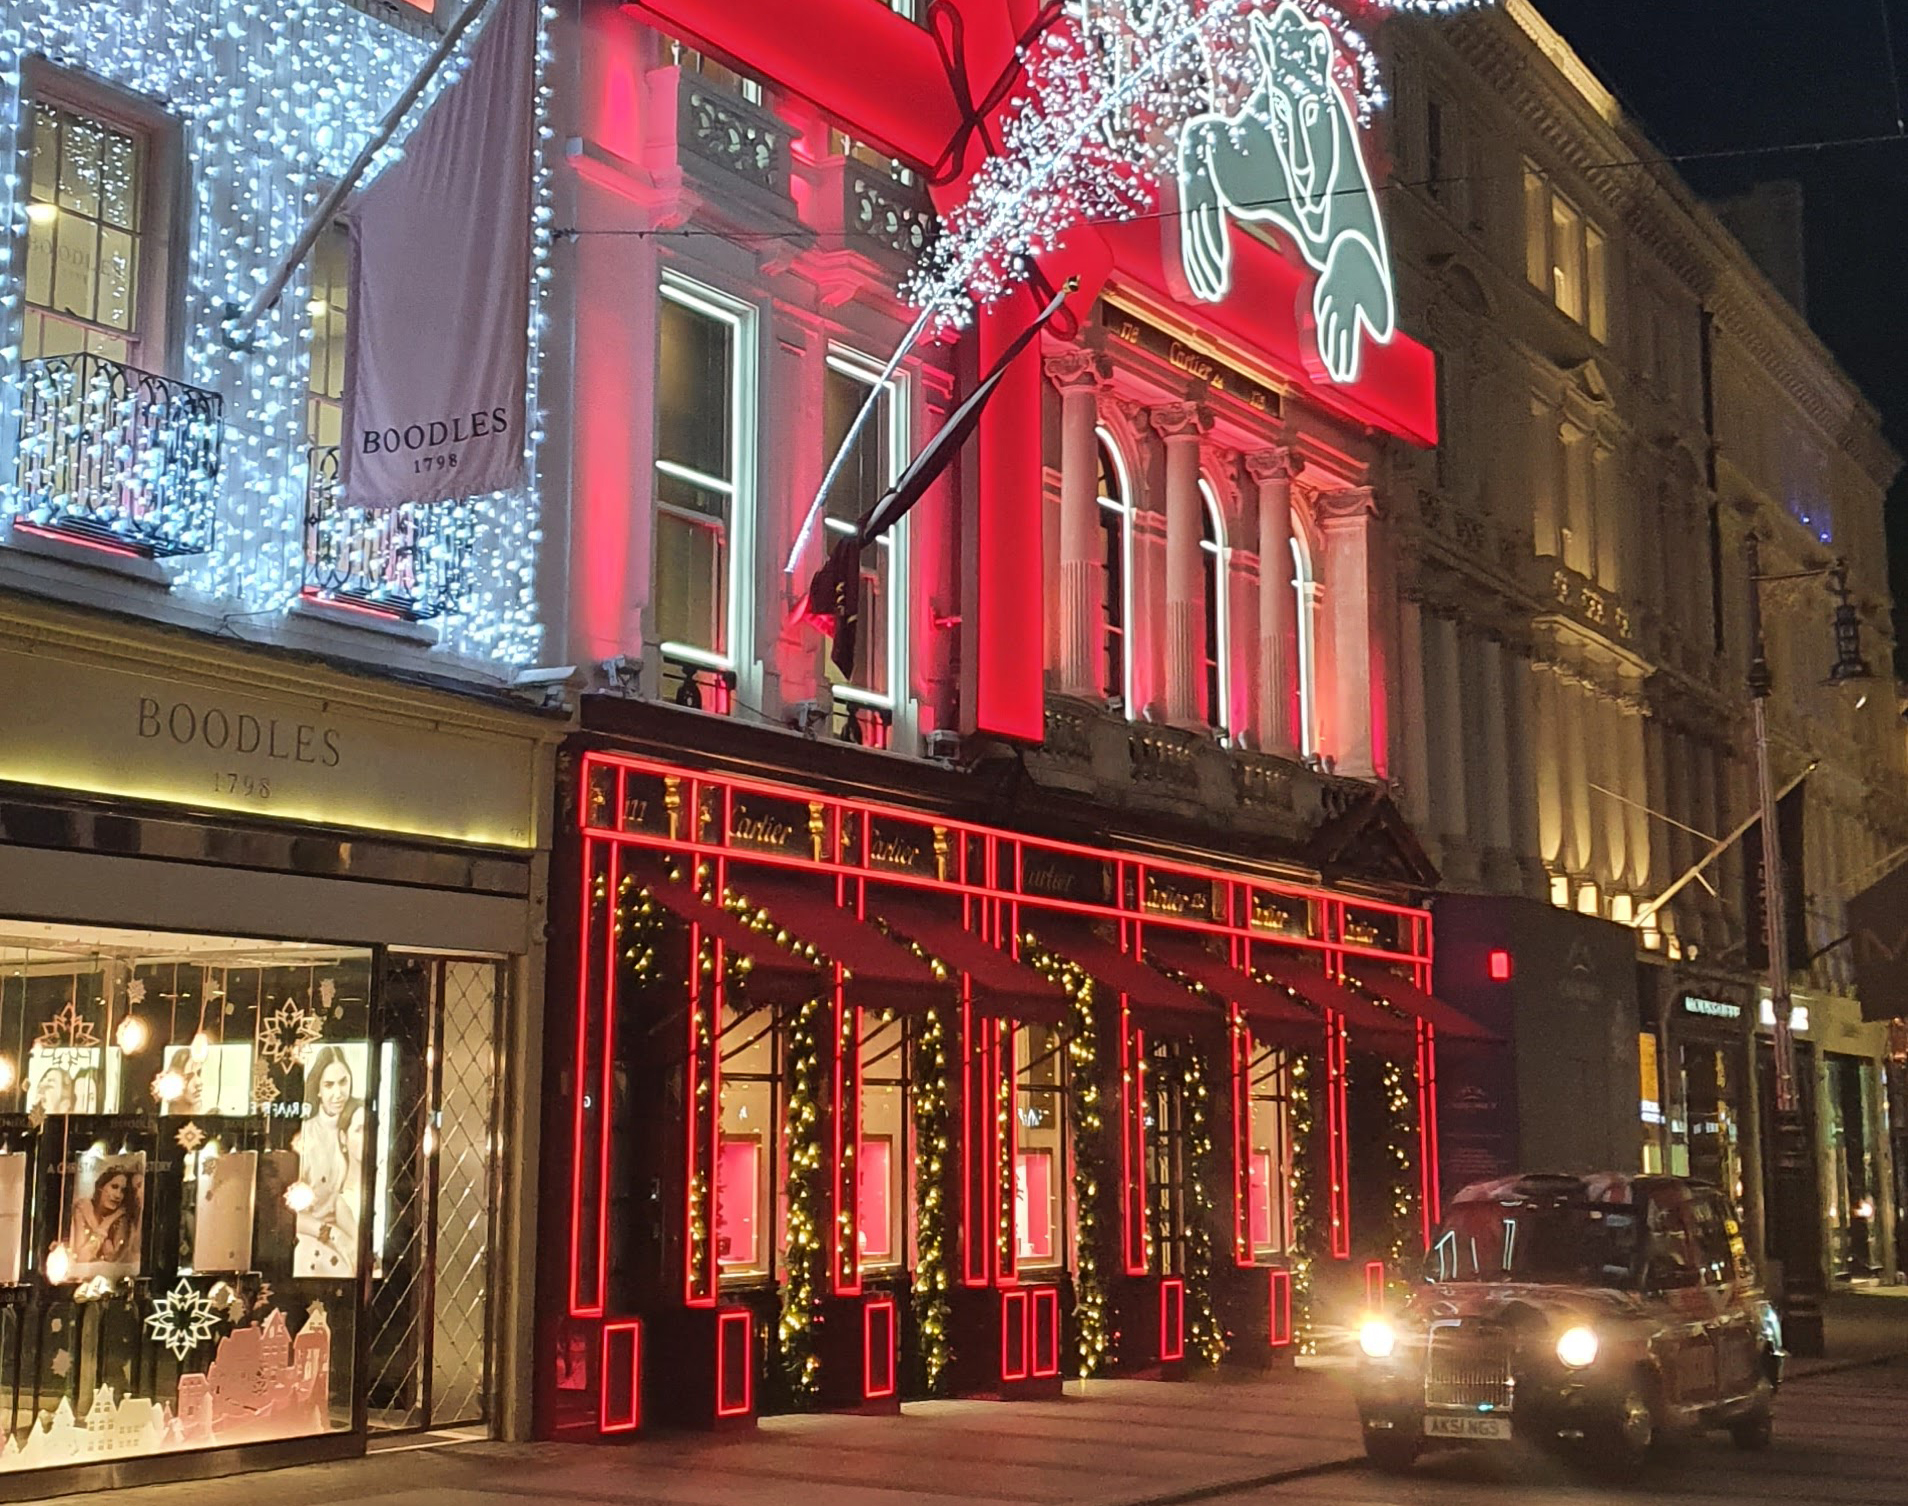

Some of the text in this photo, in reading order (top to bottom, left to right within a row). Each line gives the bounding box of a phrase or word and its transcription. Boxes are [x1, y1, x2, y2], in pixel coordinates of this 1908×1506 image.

[363, 407, 508, 454] BOODLES
[414, 453, 458, 474] 1798
[138, 695, 340, 768] BOODLES
[213, 771, 271, 799] 1798
